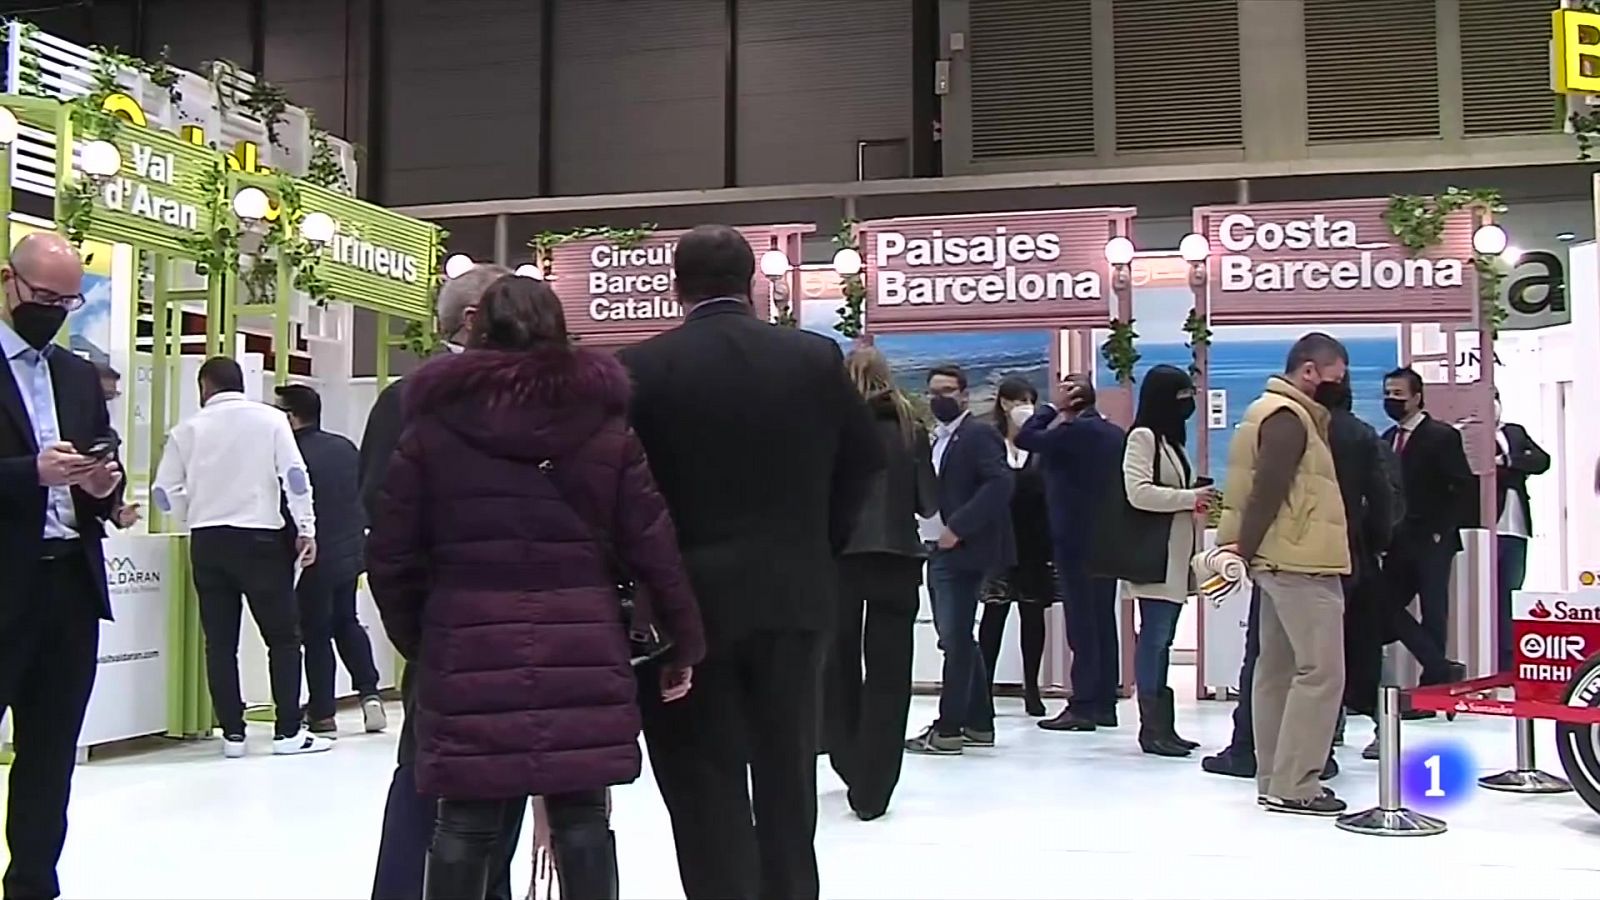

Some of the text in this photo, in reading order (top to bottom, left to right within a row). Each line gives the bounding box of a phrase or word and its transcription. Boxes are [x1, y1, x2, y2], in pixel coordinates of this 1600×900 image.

[132, 142, 174, 185] Val
[104, 176, 197, 230] d'Aran
[876, 227, 1060, 270] Paisajes
[1219, 214, 1356, 251] Costa
[310, 233, 417, 283] irineus
[591, 242, 677, 268] Circui
[1220, 251, 1463, 291] Barcelona
[589, 268, 677, 294] Barcel
[877, 267, 1101, 306] Barcelona
